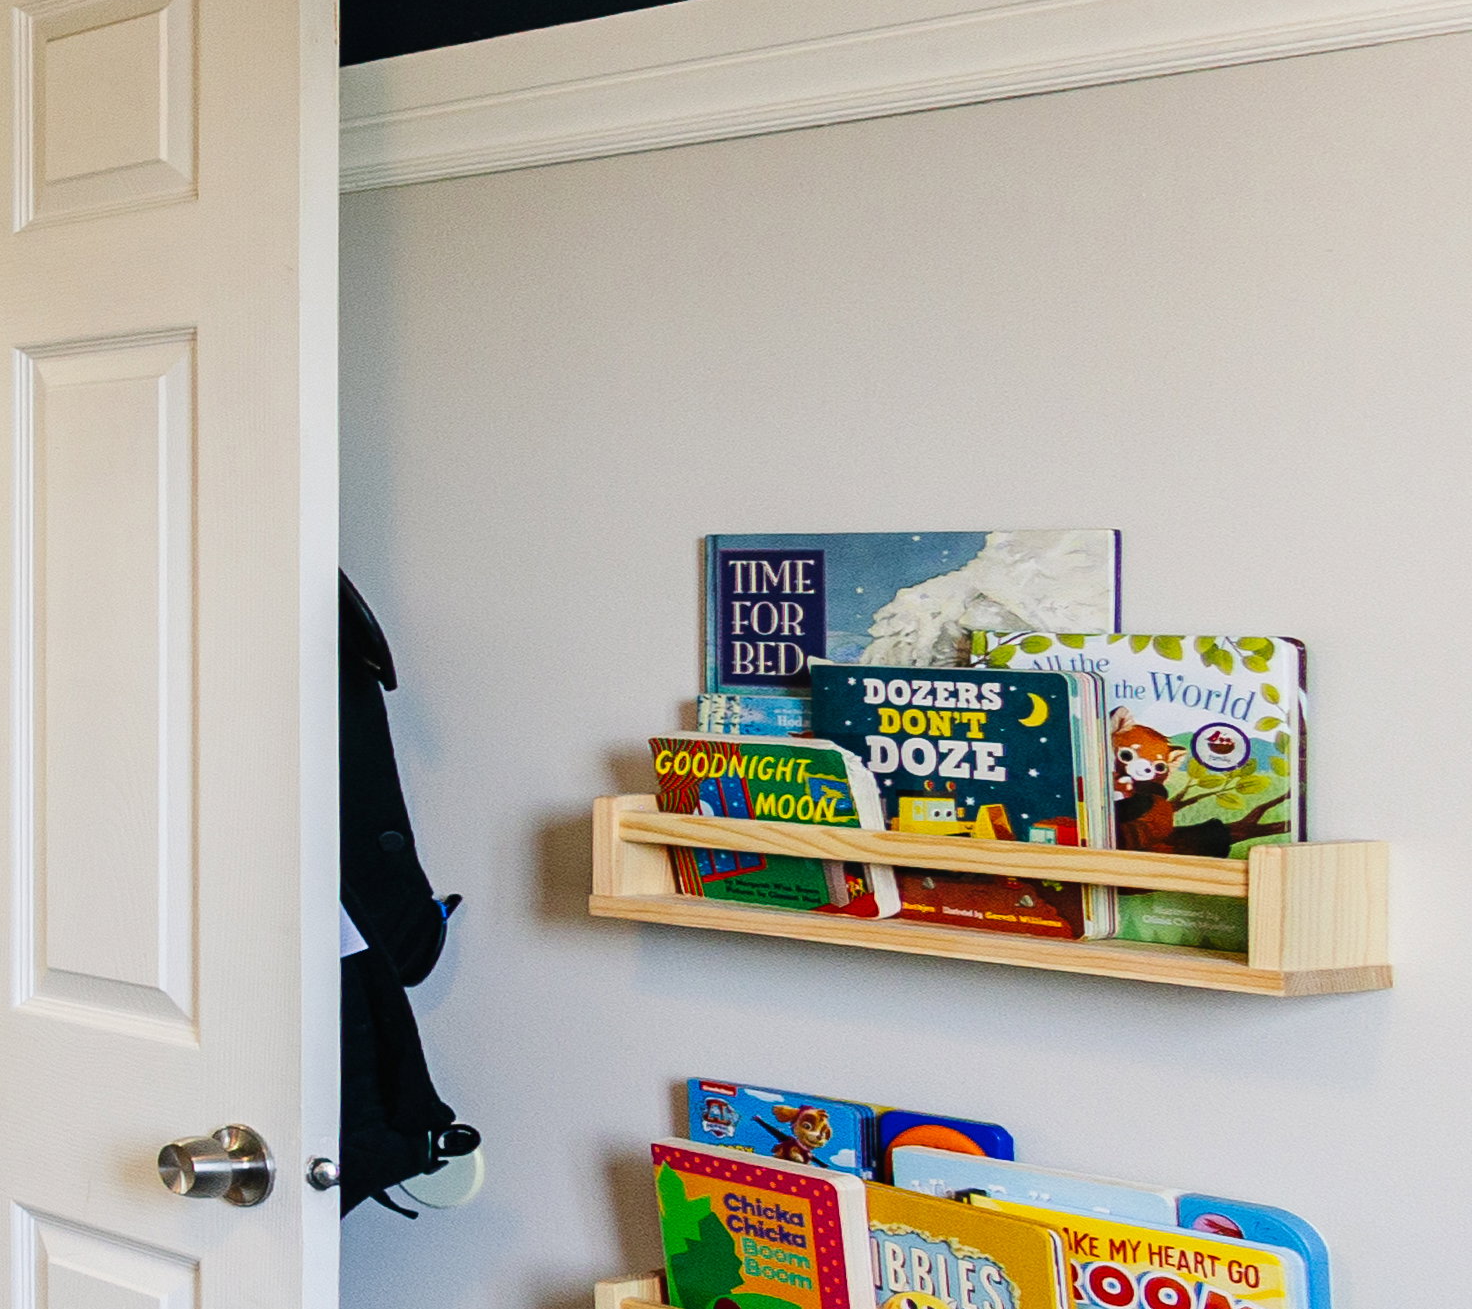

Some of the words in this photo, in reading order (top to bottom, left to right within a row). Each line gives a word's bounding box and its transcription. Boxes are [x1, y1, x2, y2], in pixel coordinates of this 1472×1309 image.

[729, 559, 815, 594] TIME
[731, 601, 805, 636] FOR
[731, 641, 804, 676] BED
[1070, 653, 1110, 673] the
[863, 678, 1002, 710] DOZERS
[1114, 680, 1145, 700] the
[1148, 670, 1256, 722] World
[878, 707, 986, 739] DON'T
[655, 749, 813, 784] GOODNIGHT
[865, 735, 1007, 782] DOZE
[755, 792, 837, 823] MOON
[723, 1192, 805, 1228] Chicka
[726, 1214, 807, 1248] Chicka
[742, 1236, 812, 1269] Boom
[1109, 1238, 1141, 1264] MY
[1148, 1243, 1221, 1278] HEART
[1227, 1259, 1260, 1289] GO
[744, 1256, 813, 1291] Boom
